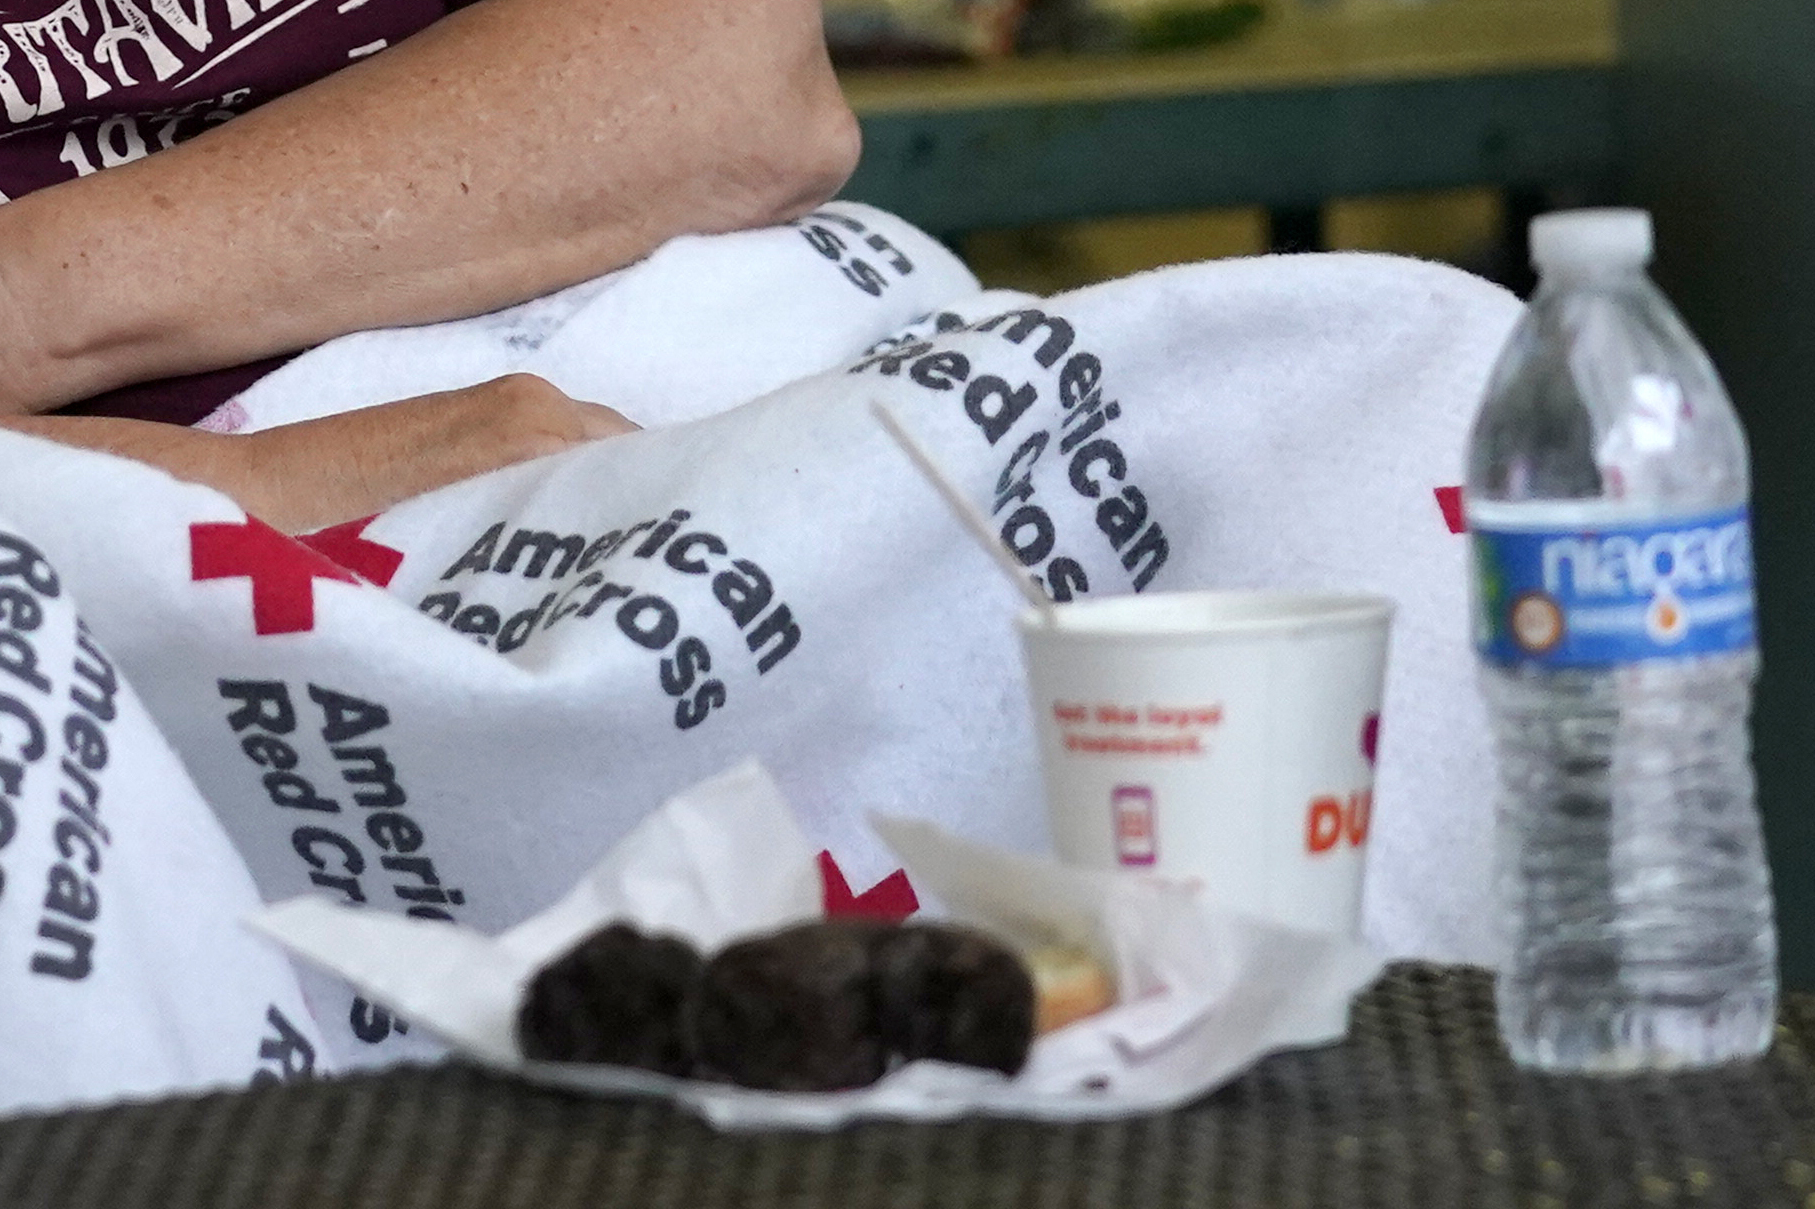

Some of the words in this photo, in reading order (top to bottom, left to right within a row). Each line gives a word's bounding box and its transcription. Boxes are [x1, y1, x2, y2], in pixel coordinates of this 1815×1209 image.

[439, 509, 802, 676] American
[31, 615, 119, 982] merican
[217, 677, 342, 814] Red
